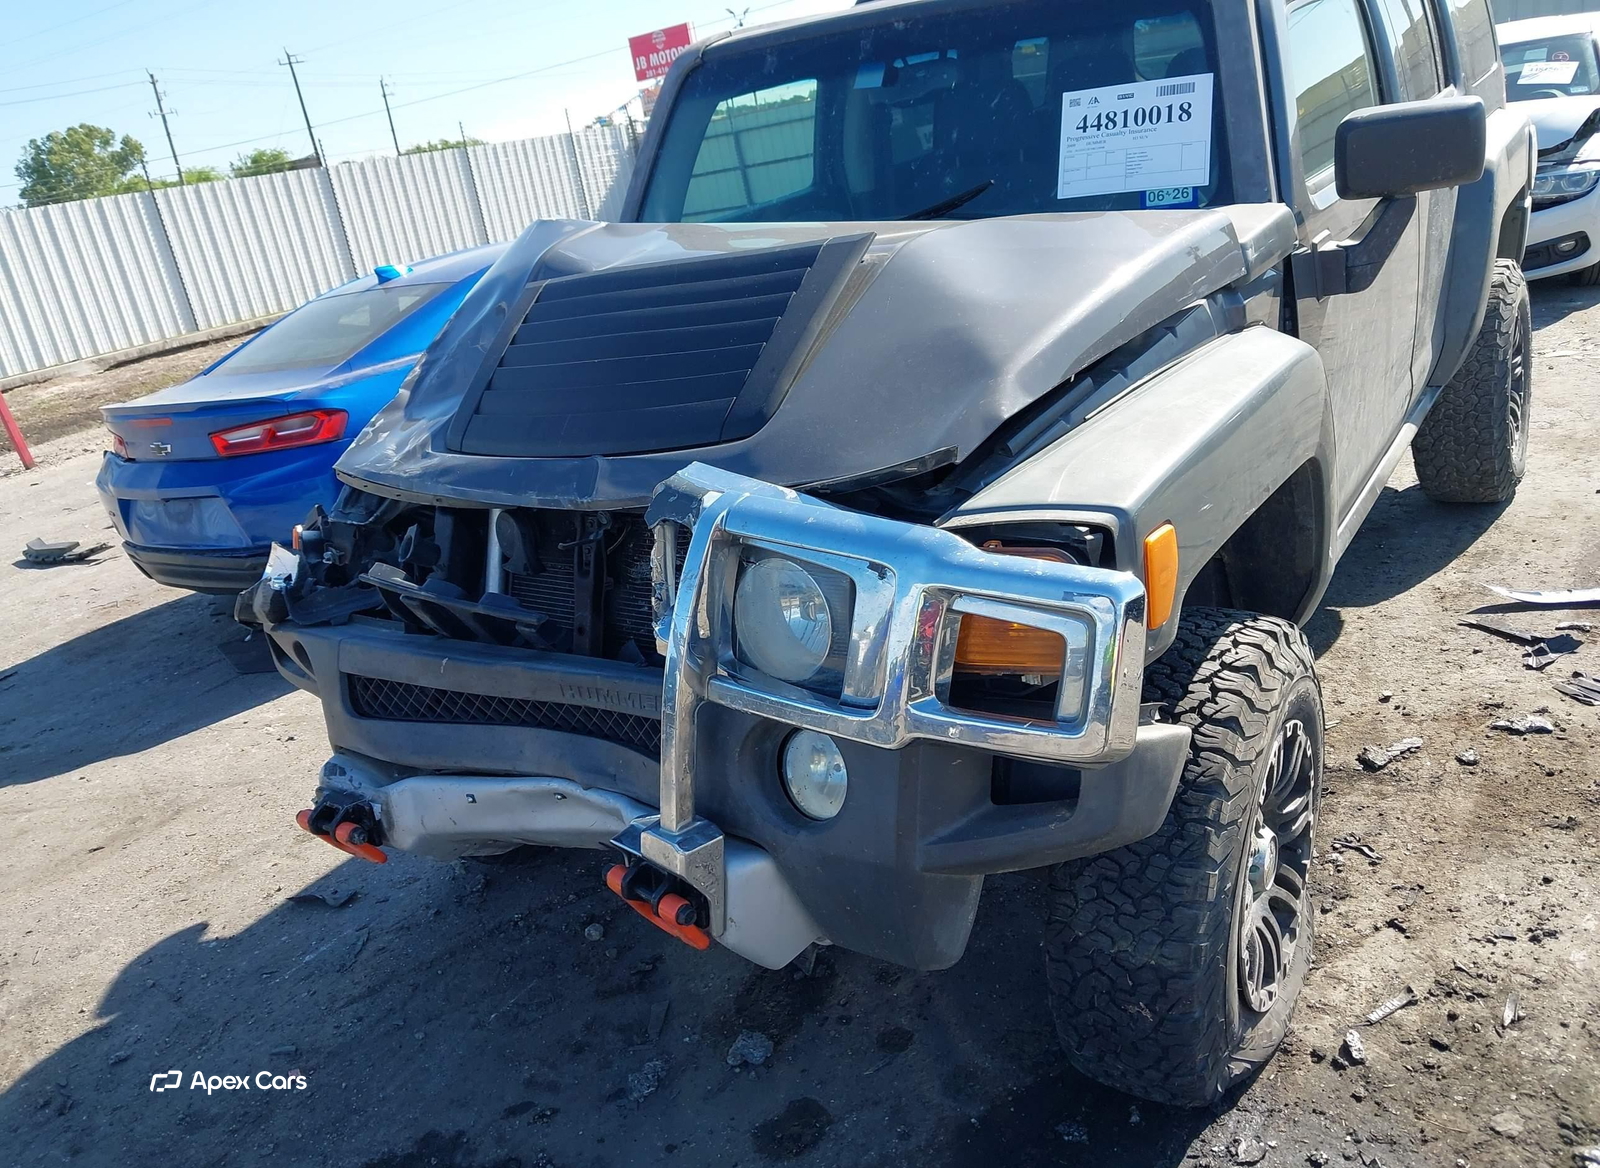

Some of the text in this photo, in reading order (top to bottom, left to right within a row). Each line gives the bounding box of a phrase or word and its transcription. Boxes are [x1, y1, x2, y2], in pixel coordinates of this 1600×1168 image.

[636, 44, 690, 71] JB MOTO
[1075, 101, 1193, 134] 44810018
[1066, 126, 1158, 143] Progressive Casualty Insurance
[1147, 187, 1190, 203] 06 26
